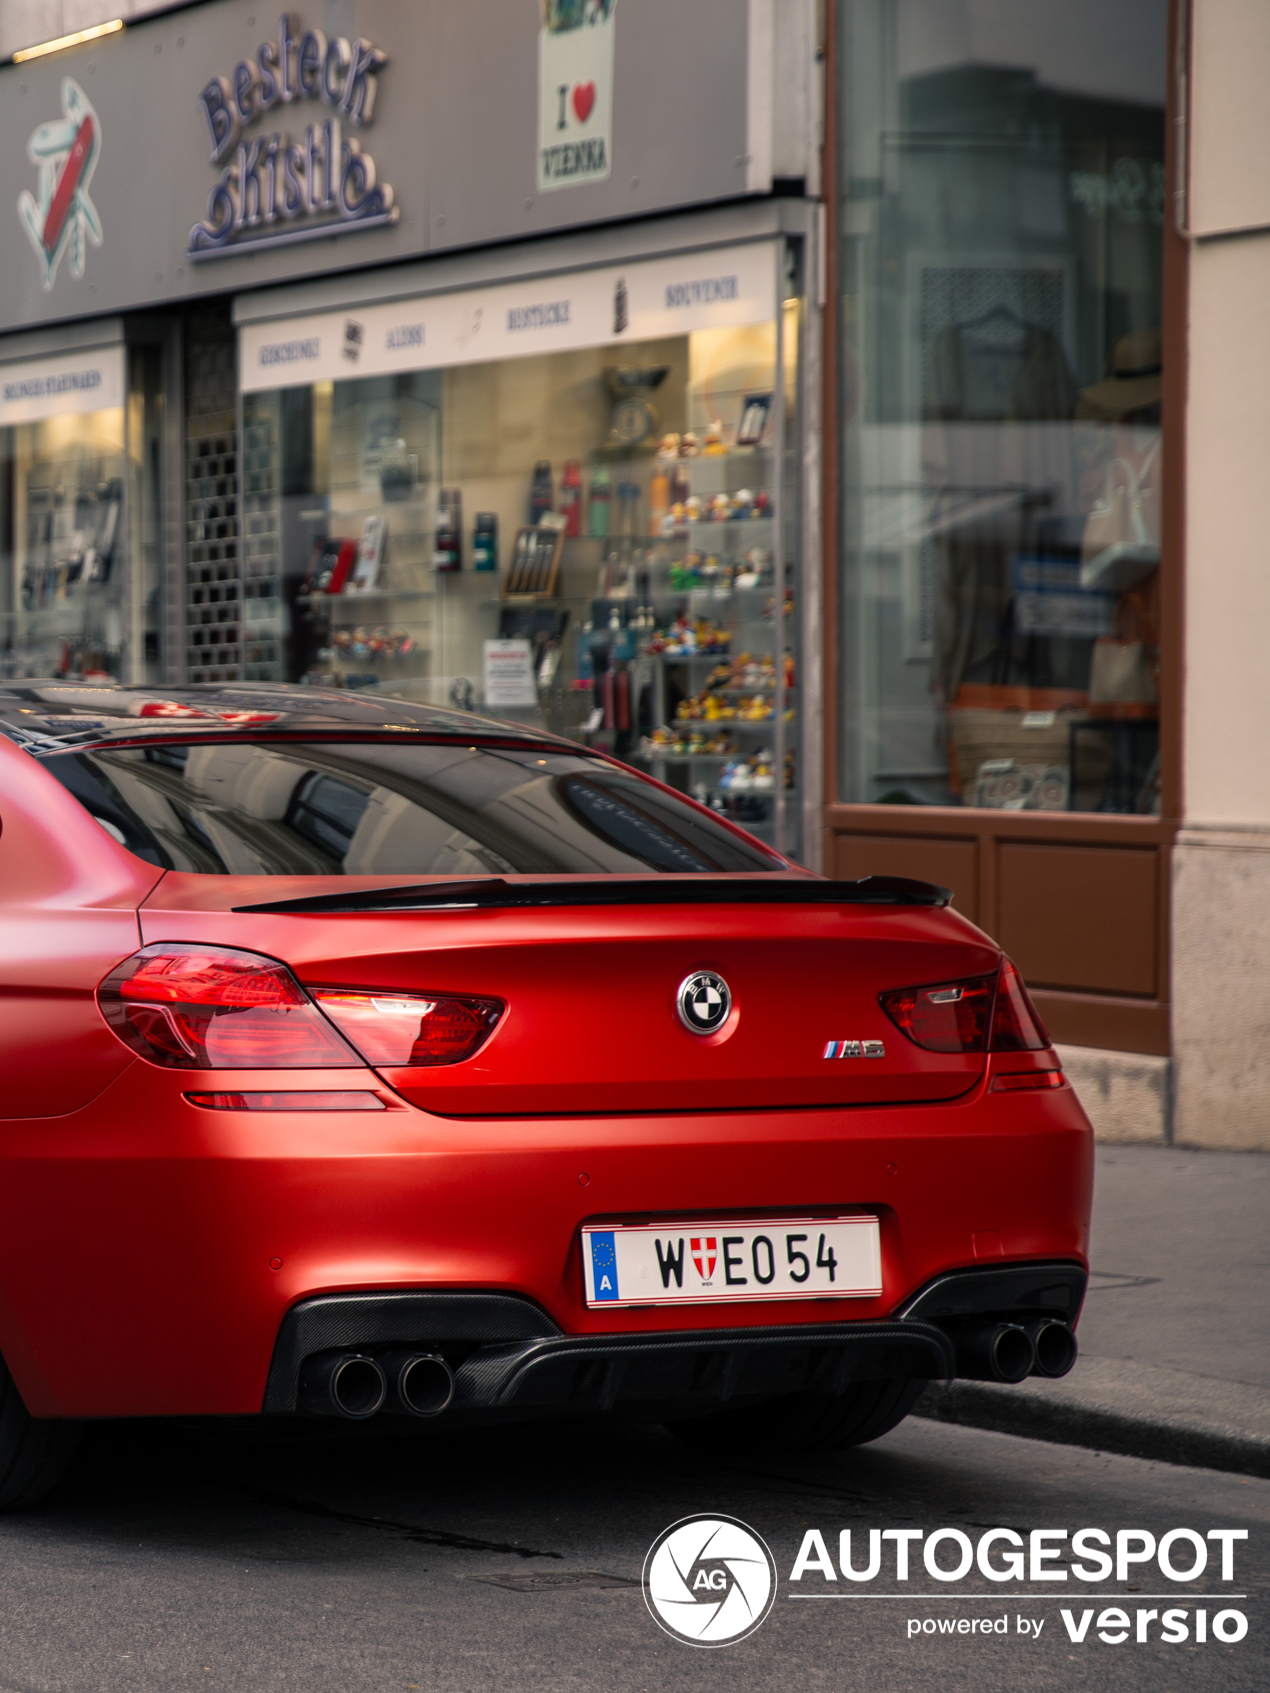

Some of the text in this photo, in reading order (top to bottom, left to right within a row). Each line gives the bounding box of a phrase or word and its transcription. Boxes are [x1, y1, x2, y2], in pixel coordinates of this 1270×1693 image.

[200, 12, 388, 163] Besteck
[557, 85, 568, 130] I
[542, 137, 606, 177] VIENNA
[689, 977, 726, 995] BMW
[839, 1040, 886, 1058] M6
[600, 1275, 612, 1290] A
[655, 1237, 684, 1288] W
